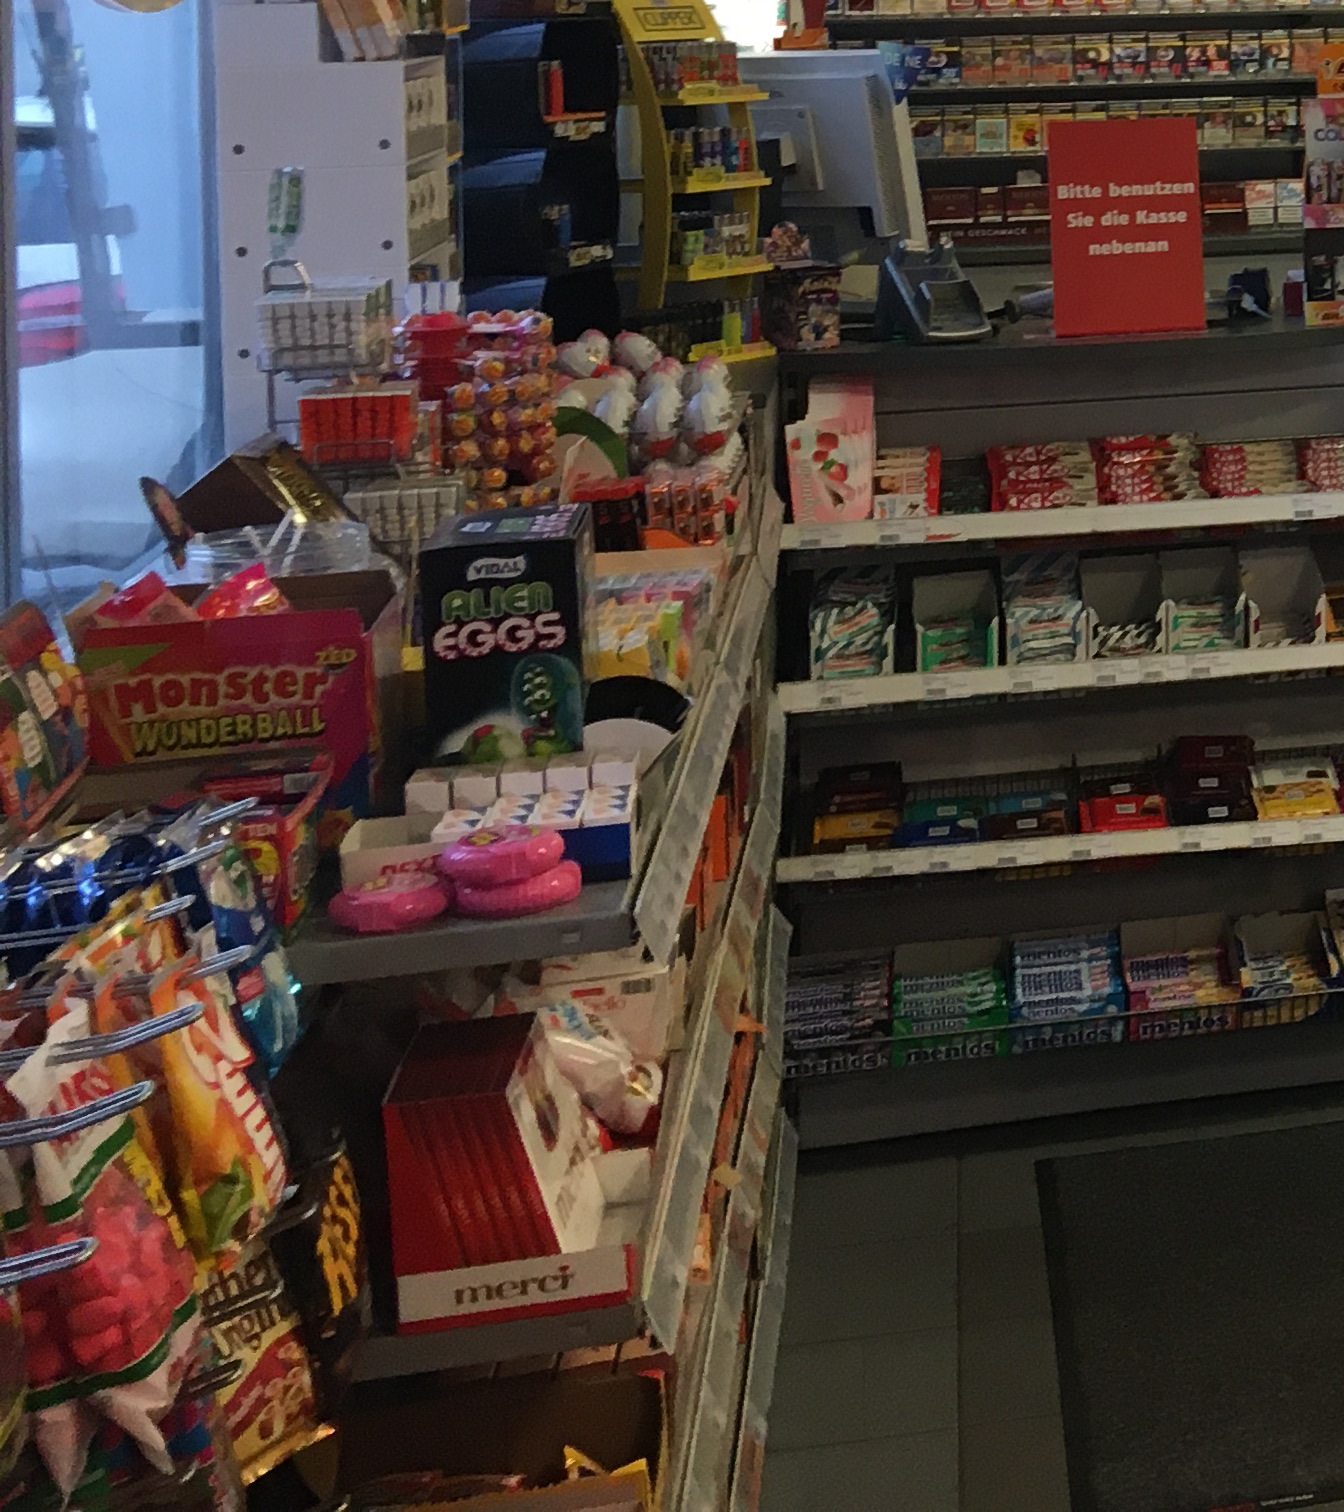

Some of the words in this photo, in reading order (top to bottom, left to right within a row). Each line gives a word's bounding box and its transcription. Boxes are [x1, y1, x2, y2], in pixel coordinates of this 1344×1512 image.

[641, 10, 697, 26] CLIPPER
[1057, 183, 1103, 200] Bitte
[1108, 180, 1196, 198] benutzen
[1067, 211, 1094, 229] Sie
[1100, 210, 1130, 227] die
[1135, 208, 1188, 226] Kasse
[1088, 238, 1170, 256] nebenan
[472, 559, 522, 576] VIDAL
[432, 611, 567, 661] EGGS
[114, 666, 329, 720] Monster
[130, 707, 327, 755] WUNDERBALL
[1139, 1012, 1231, 1037] mentos
[1025, 1024, 1114, 1051] mentos
[783, 1050, 881, 1078] mentos
[905, 1040, 994, 1065] mentos
[454, 1265, 576, 1306] merci
